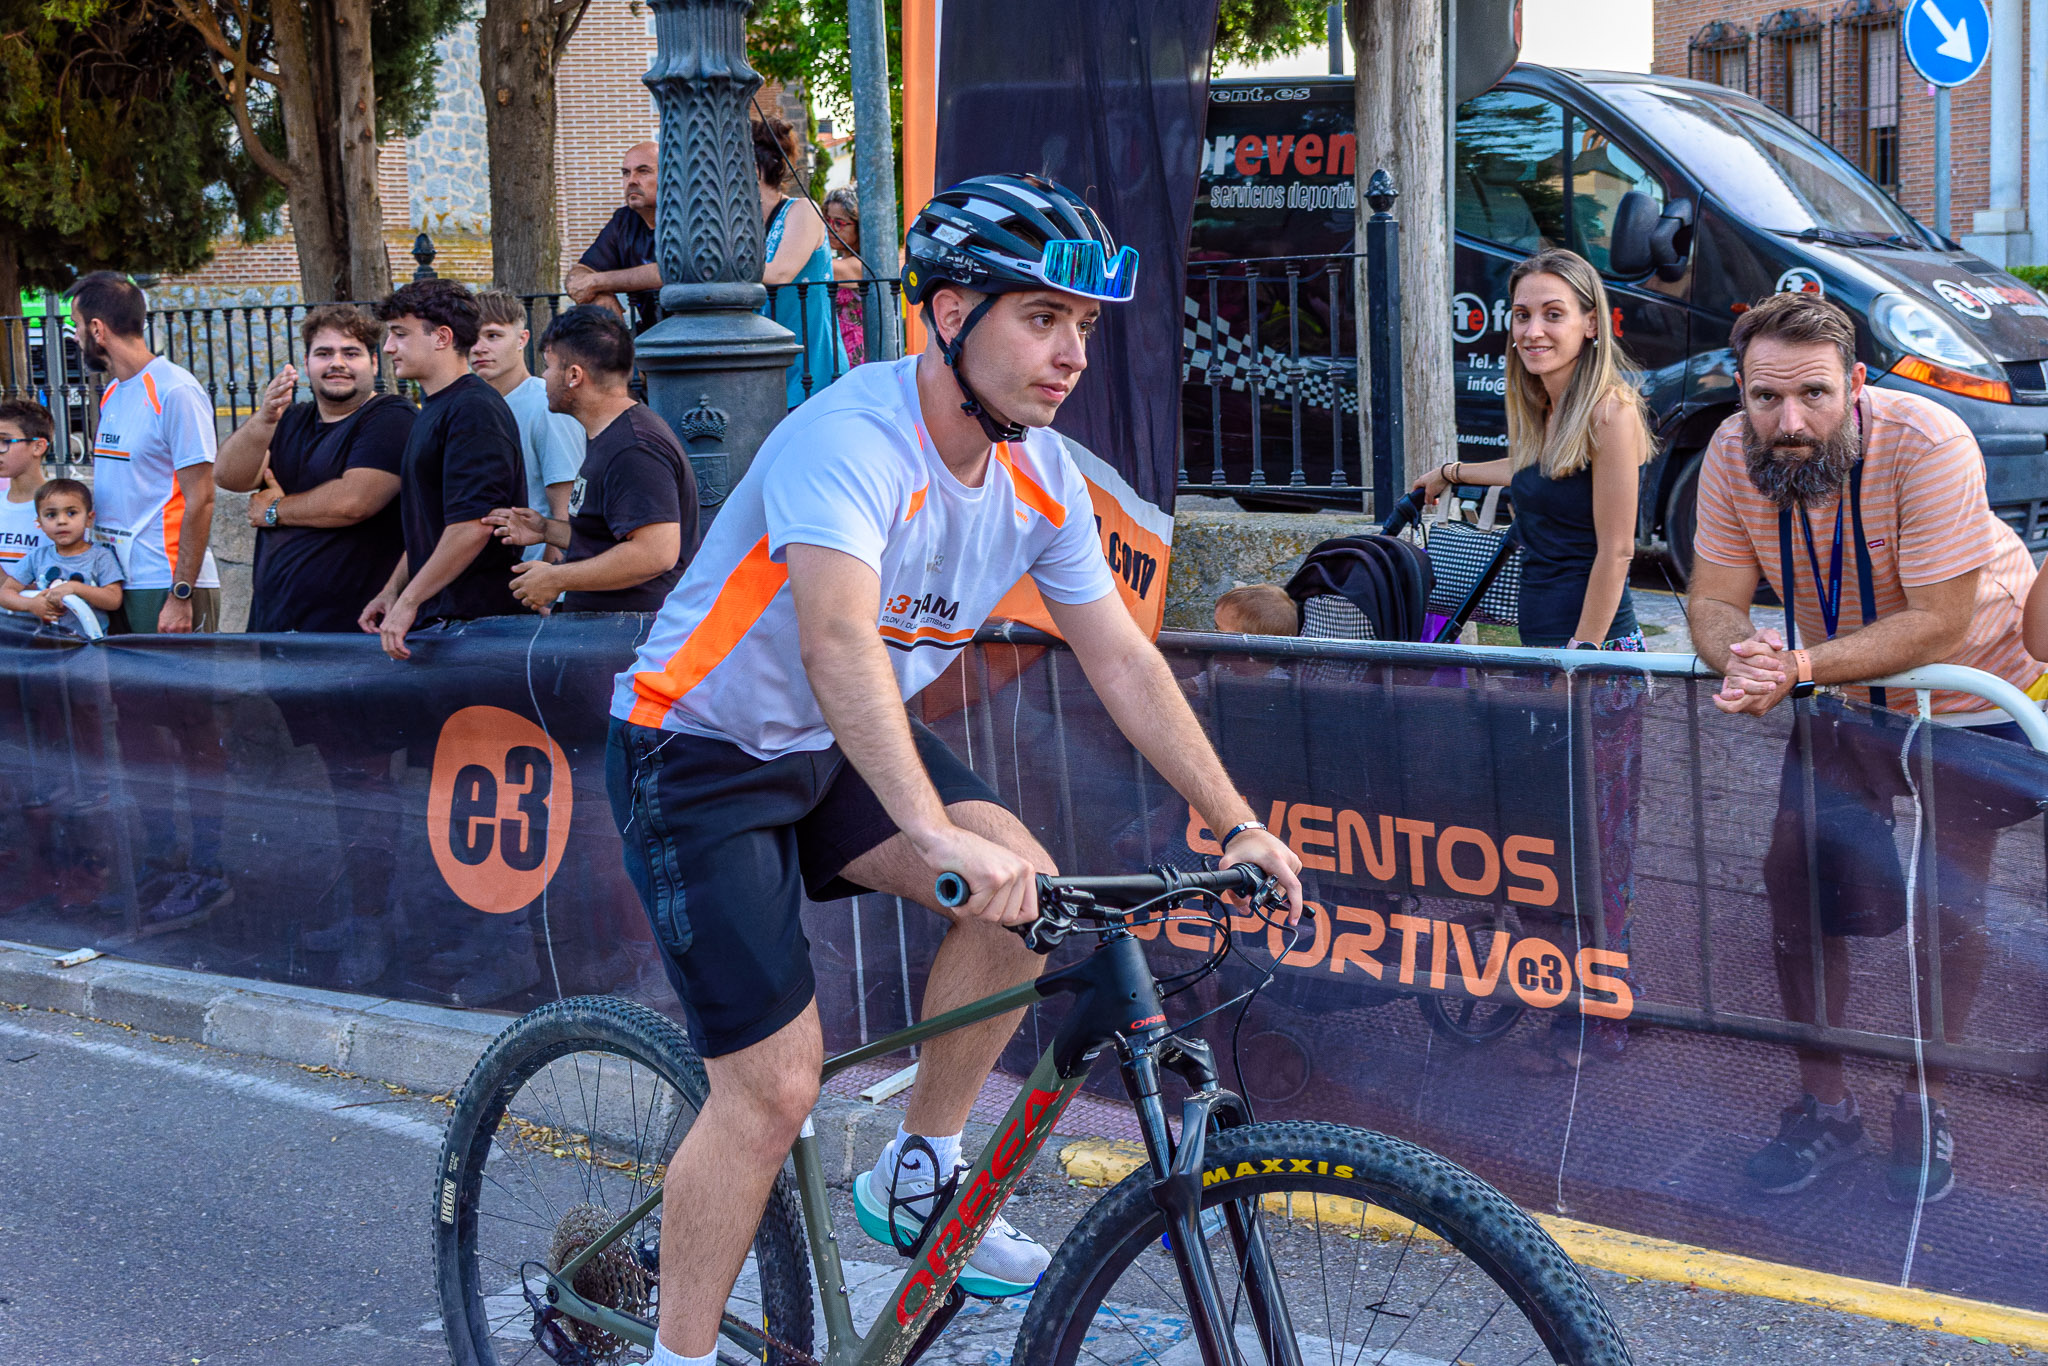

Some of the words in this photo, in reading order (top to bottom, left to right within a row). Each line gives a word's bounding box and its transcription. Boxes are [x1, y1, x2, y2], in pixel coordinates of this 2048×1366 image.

[1208, 87, 1311, 103] ent.es
[1201, 134, 1356, 175] reven
[1210, 181, 1285, 209] servicios
[1468, 352, 1493, 369] Tel.
[449, 744, 553, 872] e3
[1518, 953, 1563, 996] e3
[1202, 1158, 1354, 1187] MAXXIS
[441, 1178, 457, 1224] IKON
[896, 1087, 1064, 1327] ORBEA
